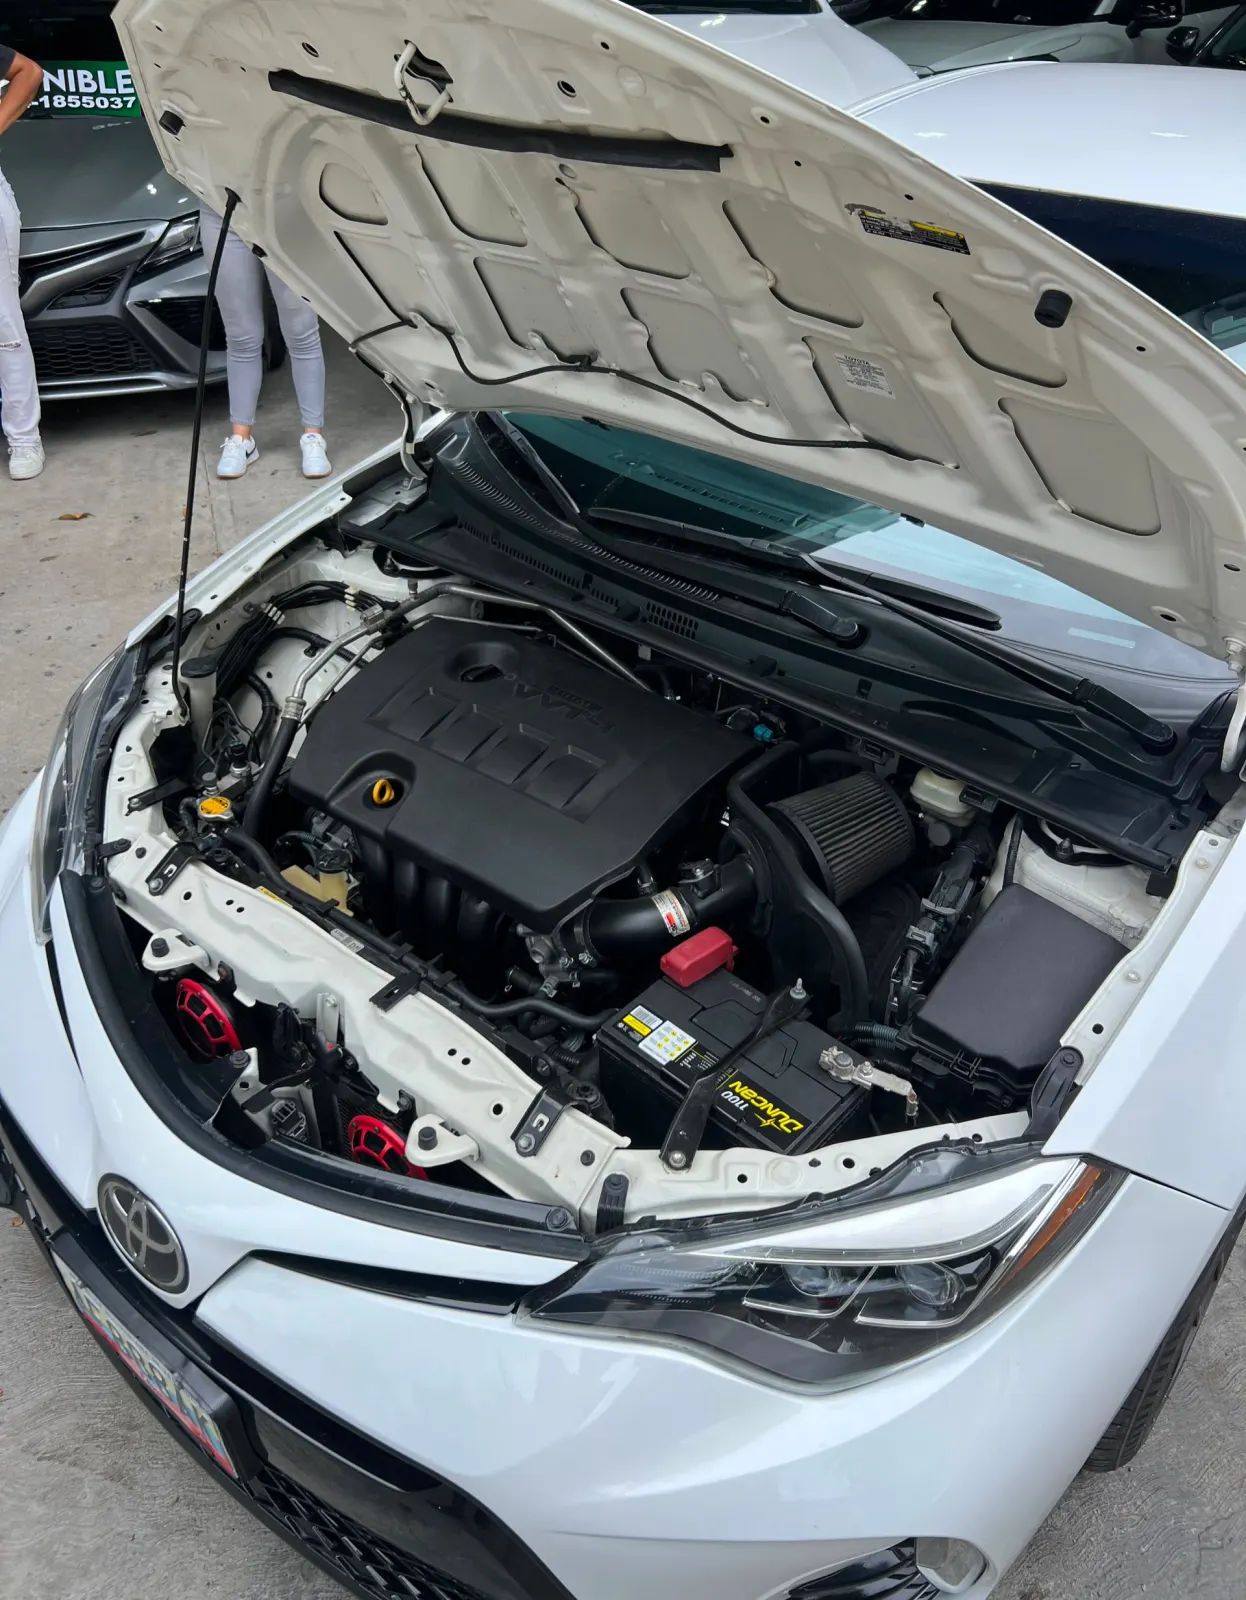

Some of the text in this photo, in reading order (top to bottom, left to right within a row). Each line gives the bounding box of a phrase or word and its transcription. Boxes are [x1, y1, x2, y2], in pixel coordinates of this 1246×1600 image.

[42, 69, 135, 94] NIBLE
[27, 95, 136, 109] -1855037
[721, 1091, 749, 1111] 1100
